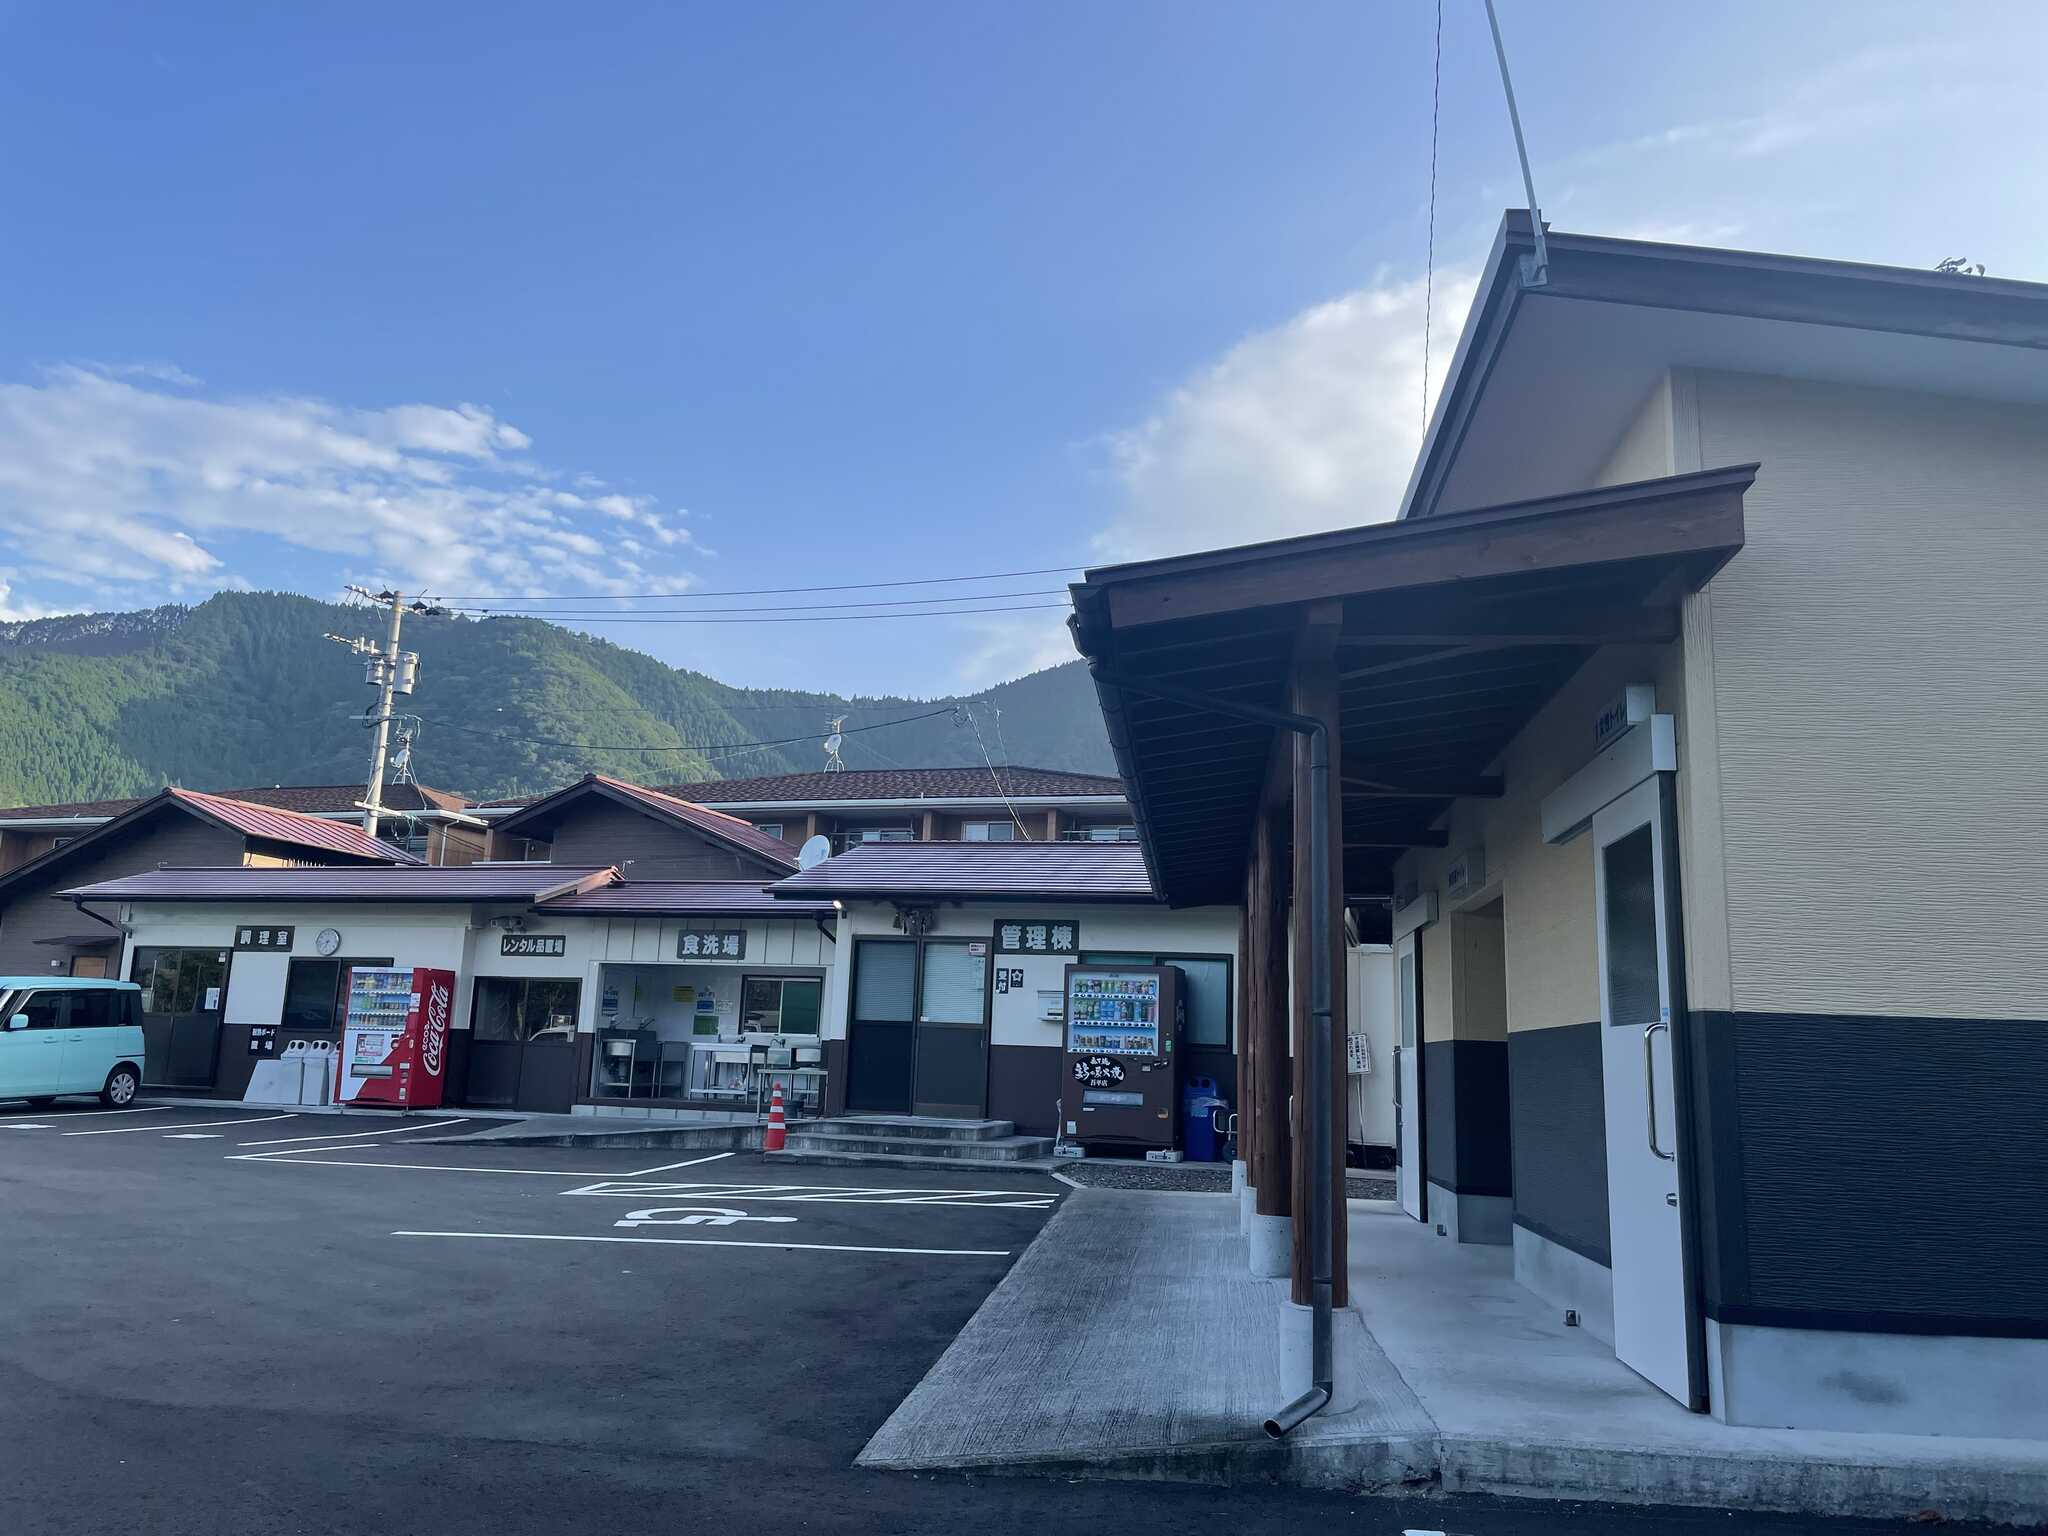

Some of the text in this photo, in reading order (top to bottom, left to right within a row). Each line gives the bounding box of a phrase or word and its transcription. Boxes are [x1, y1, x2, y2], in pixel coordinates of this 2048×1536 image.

[681, 934, 740, 956] 食洗場
[1001, 924, 1073, 950] 管理棟
[422, 980, 449, 1077] Coca-Cola
